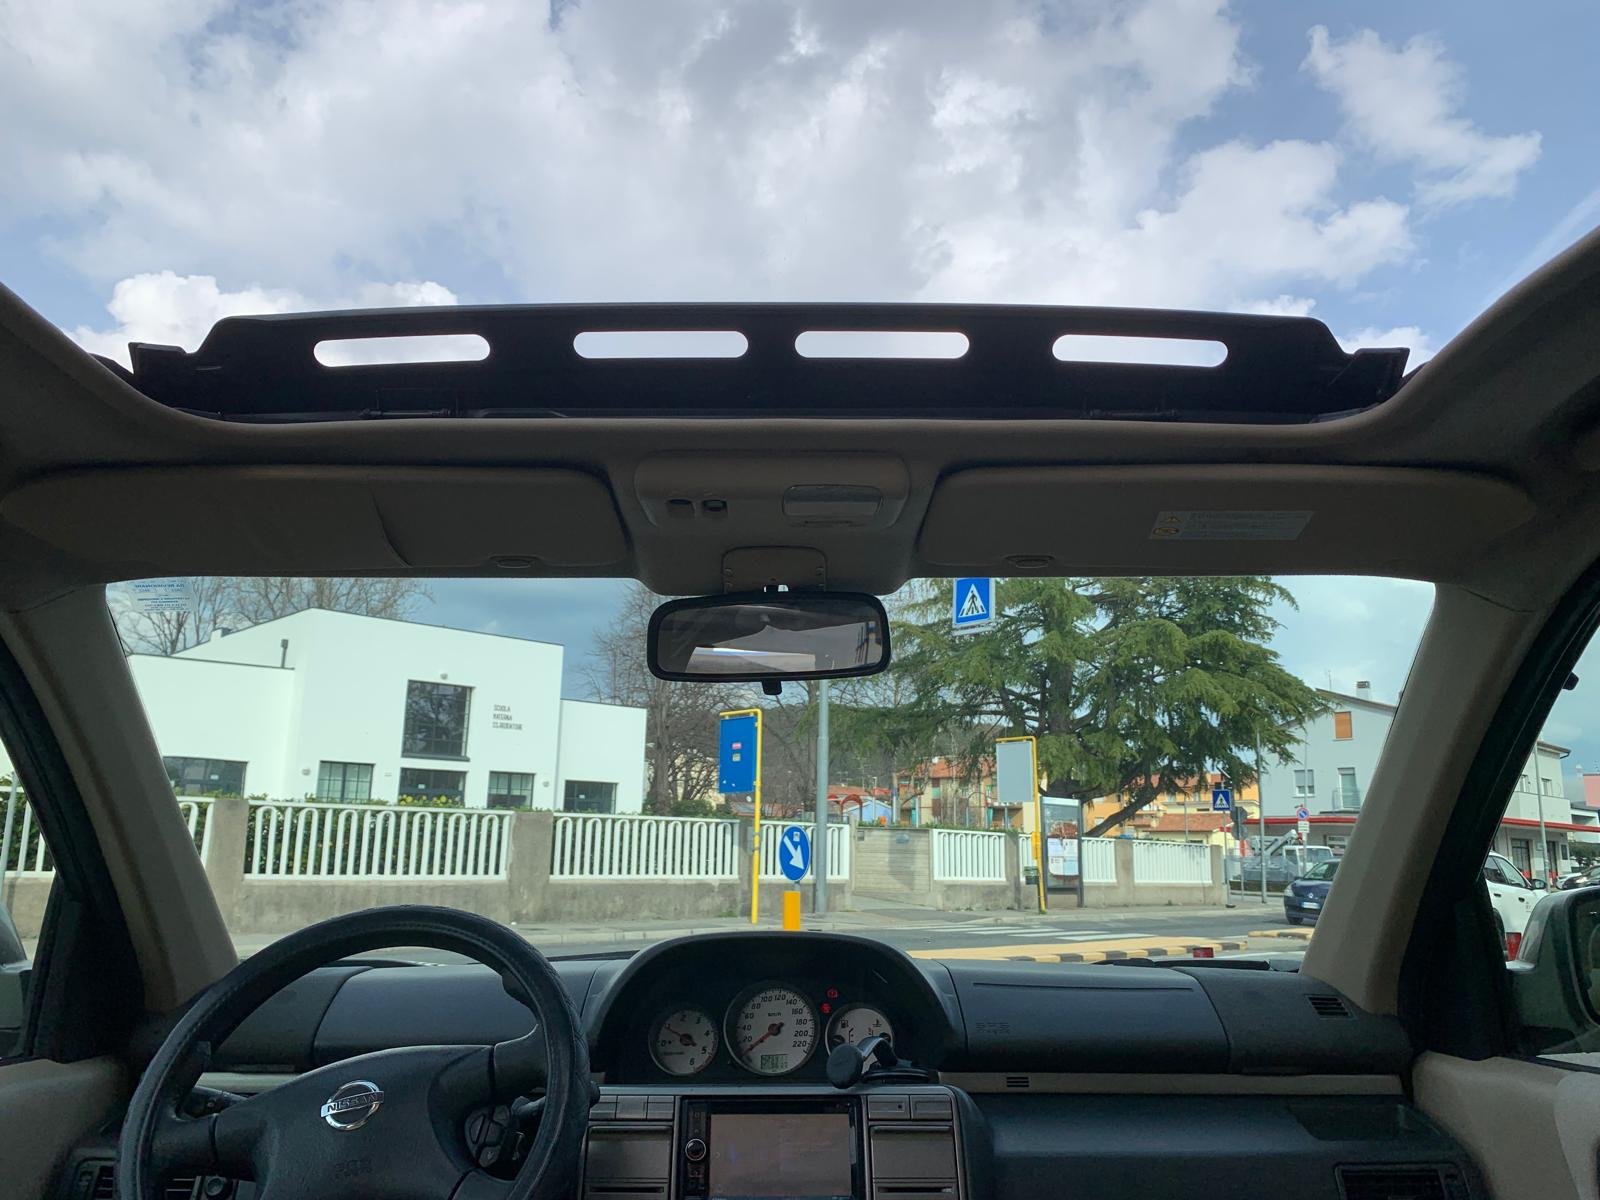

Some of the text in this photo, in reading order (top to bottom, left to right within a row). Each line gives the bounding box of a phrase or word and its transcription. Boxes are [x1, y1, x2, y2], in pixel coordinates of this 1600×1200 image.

[760, 995, 773, 1003] 100
[786, 998, 797, 1006] 140
[792, 1040, 807, 1048] 220
[701, 1046, 707, 1054] 5
[689, 1058, 695, 1066] 6
[327, 1093, 378, 1113] NISSAN
